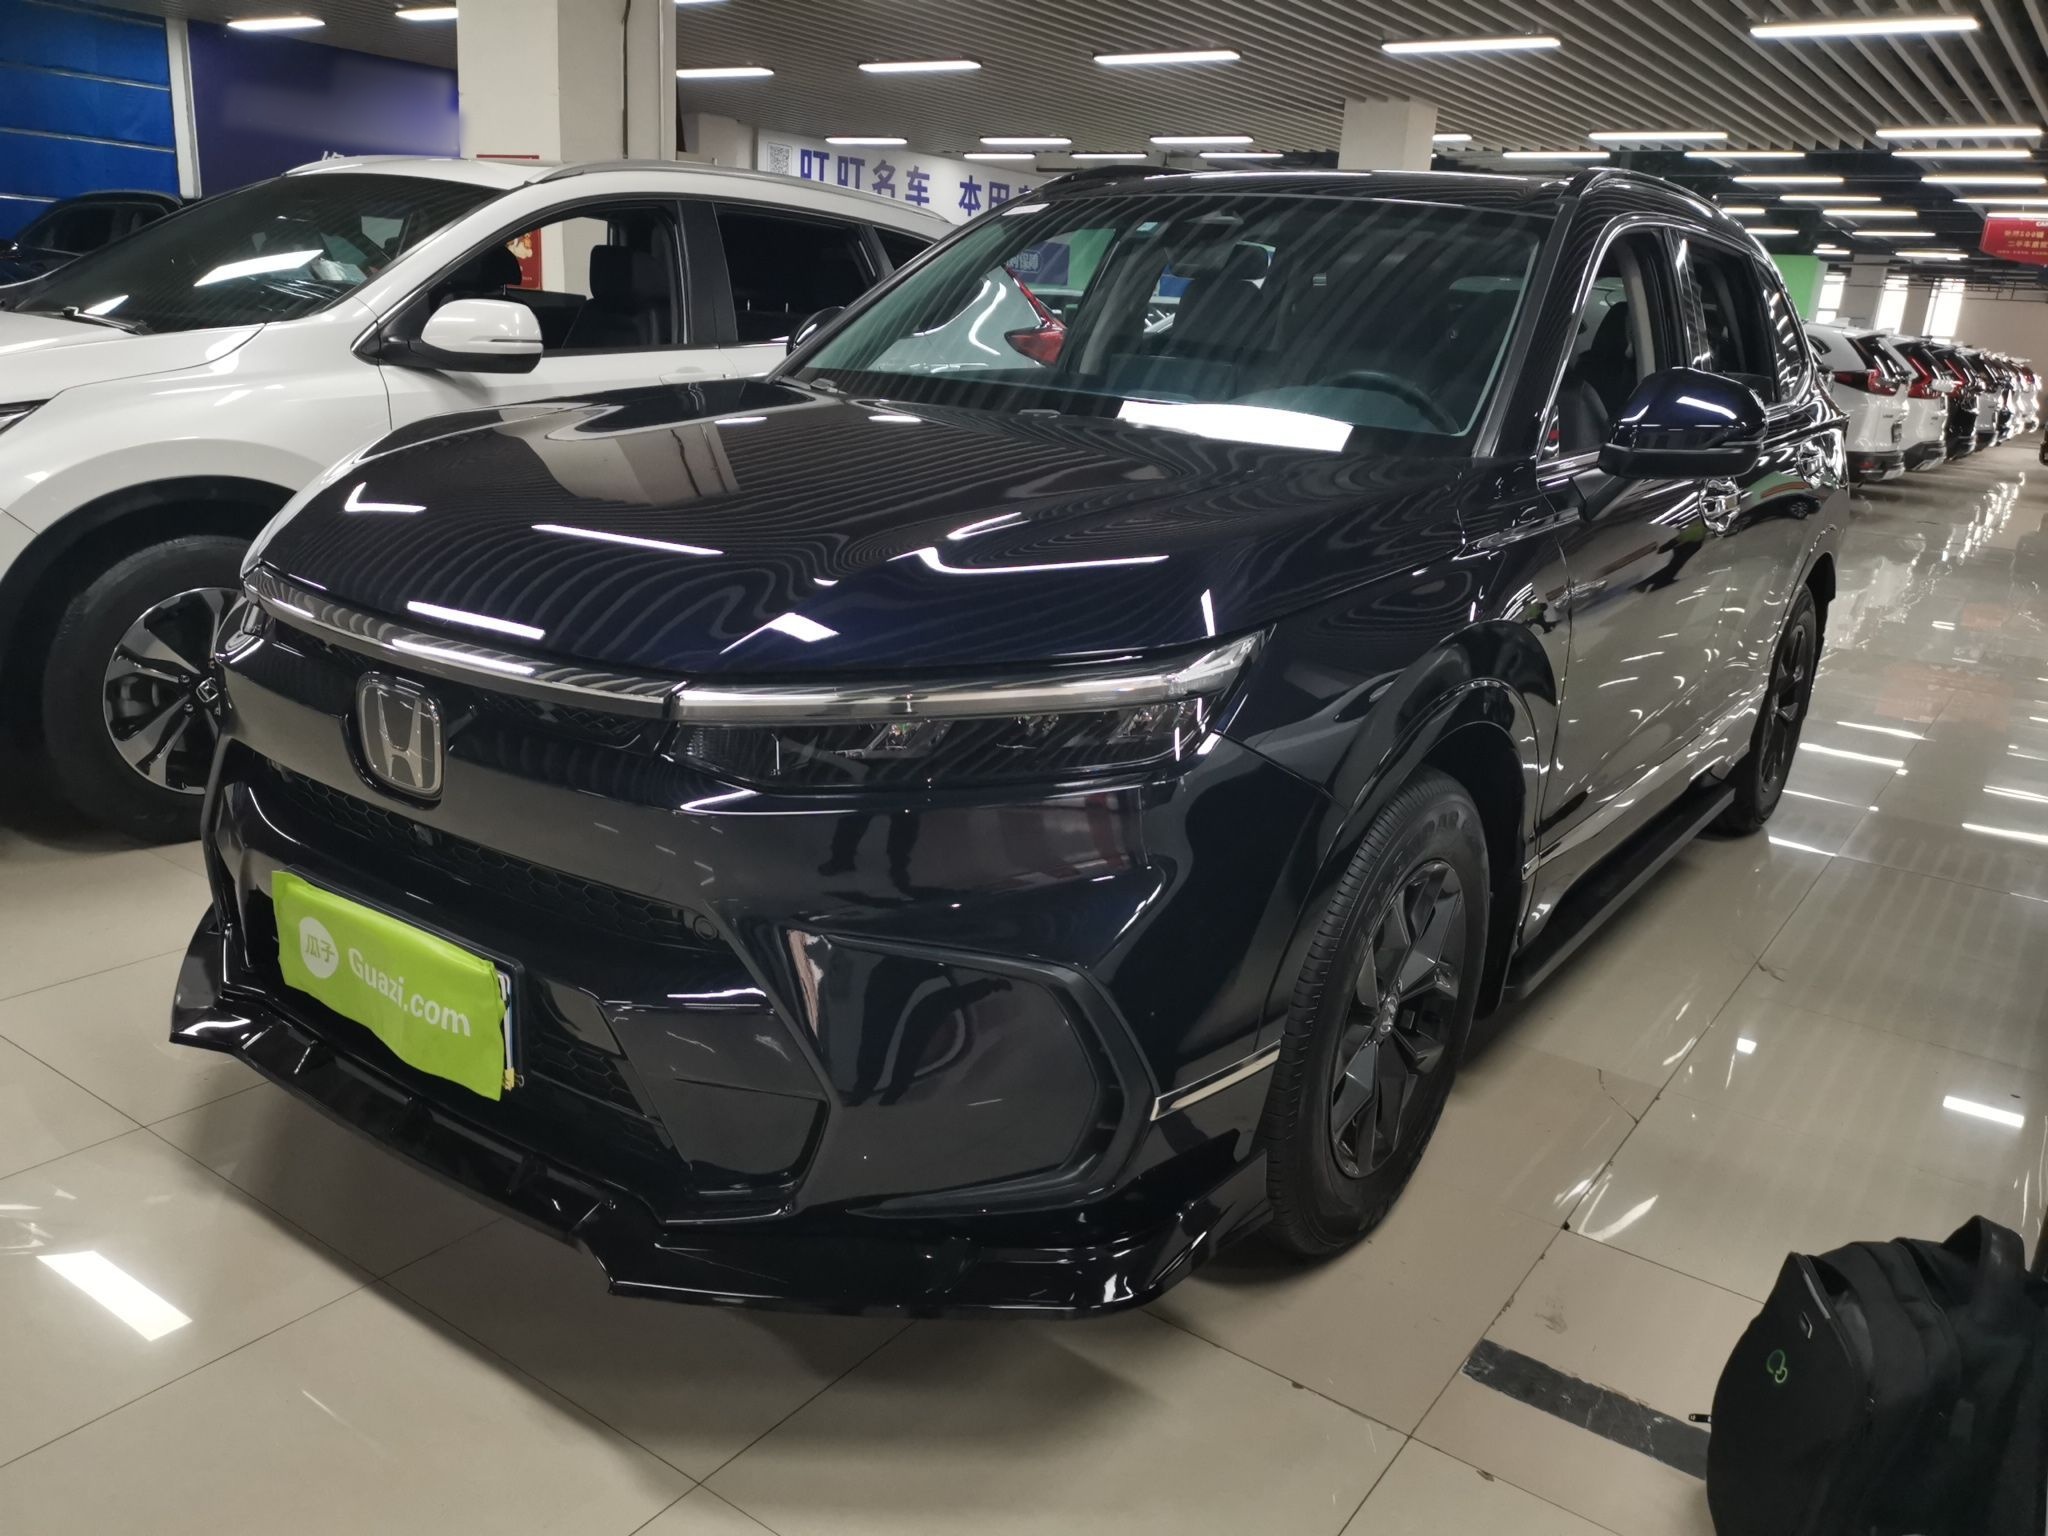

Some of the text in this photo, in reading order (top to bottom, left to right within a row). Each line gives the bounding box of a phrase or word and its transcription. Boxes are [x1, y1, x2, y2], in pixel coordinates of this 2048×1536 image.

[800, 148, 1032, 217] 叮叮名车 本田
[304, 933, 337, 964] 瓜子
[348, 947, 471, 1038] Guazi.com
